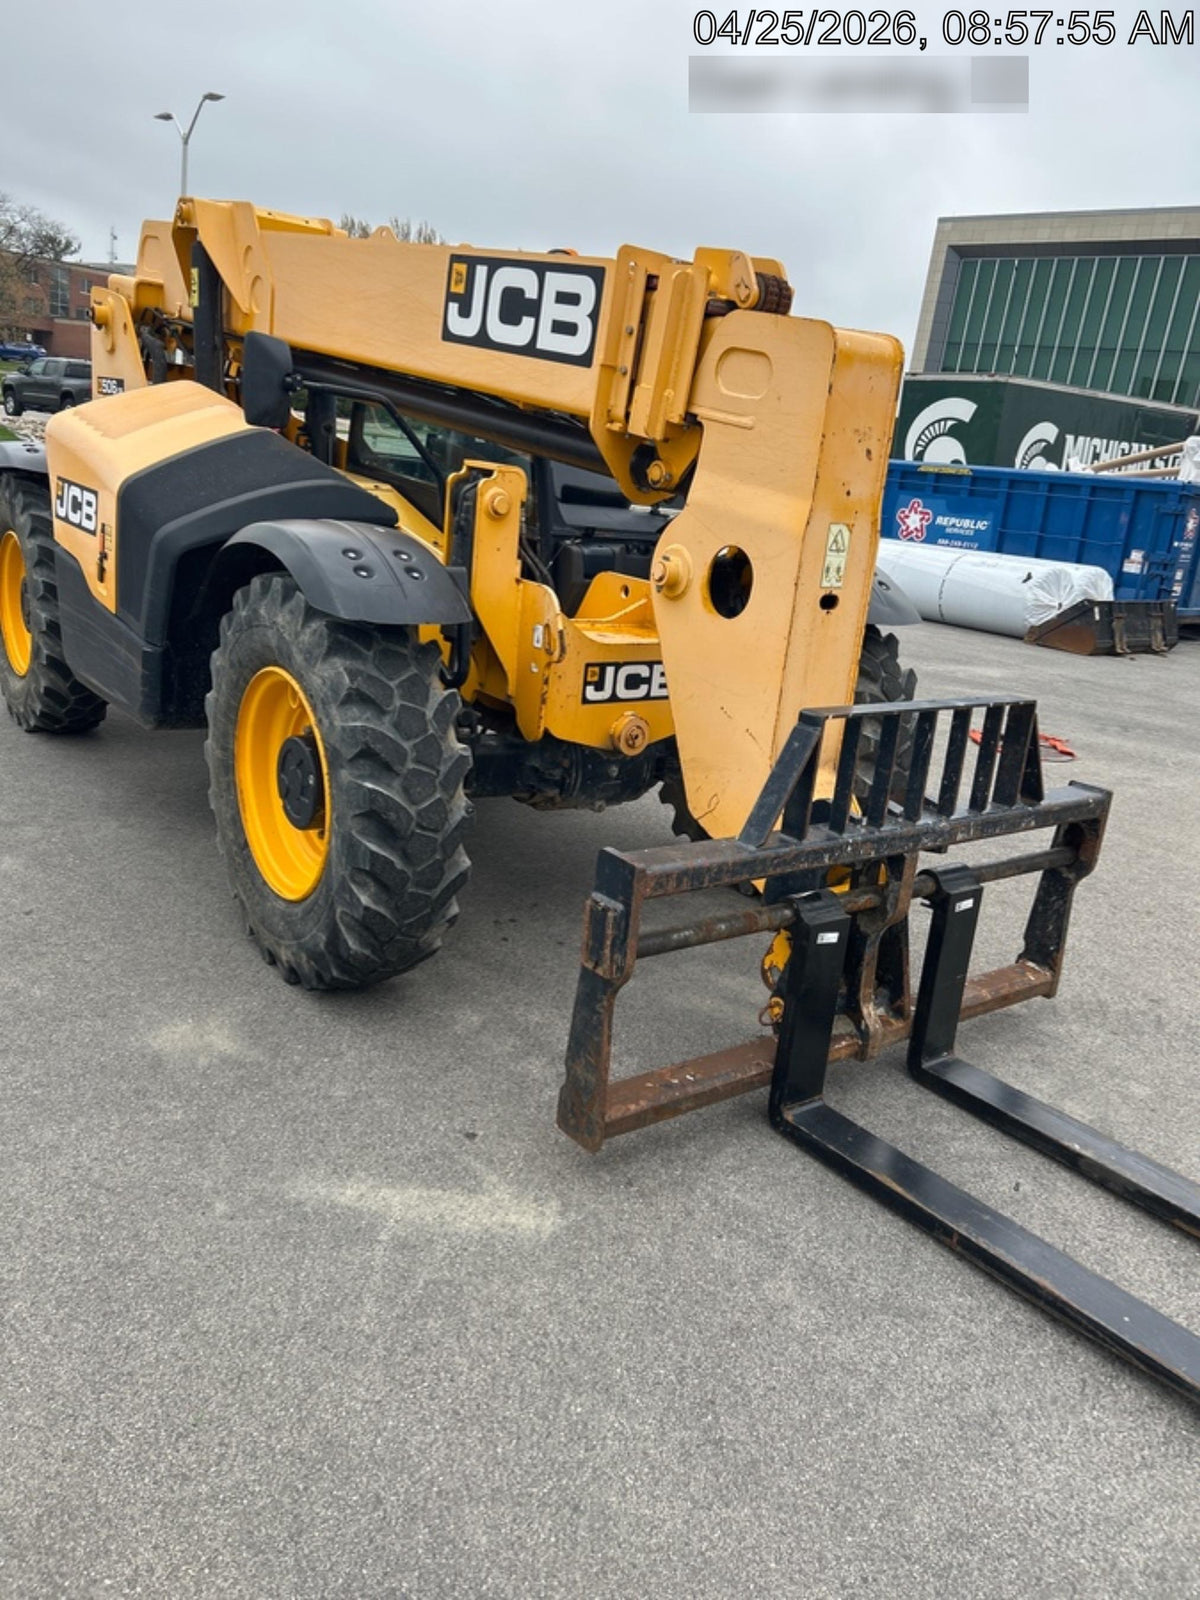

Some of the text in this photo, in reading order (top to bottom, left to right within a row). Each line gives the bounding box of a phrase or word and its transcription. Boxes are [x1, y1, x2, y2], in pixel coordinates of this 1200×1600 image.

[447, 264, 596, 357] JCB
[56, 482, 97, 531] JCB
[934, 515, 989, 531] REPUBLIC
[585, 664, 669, 701] JCB
